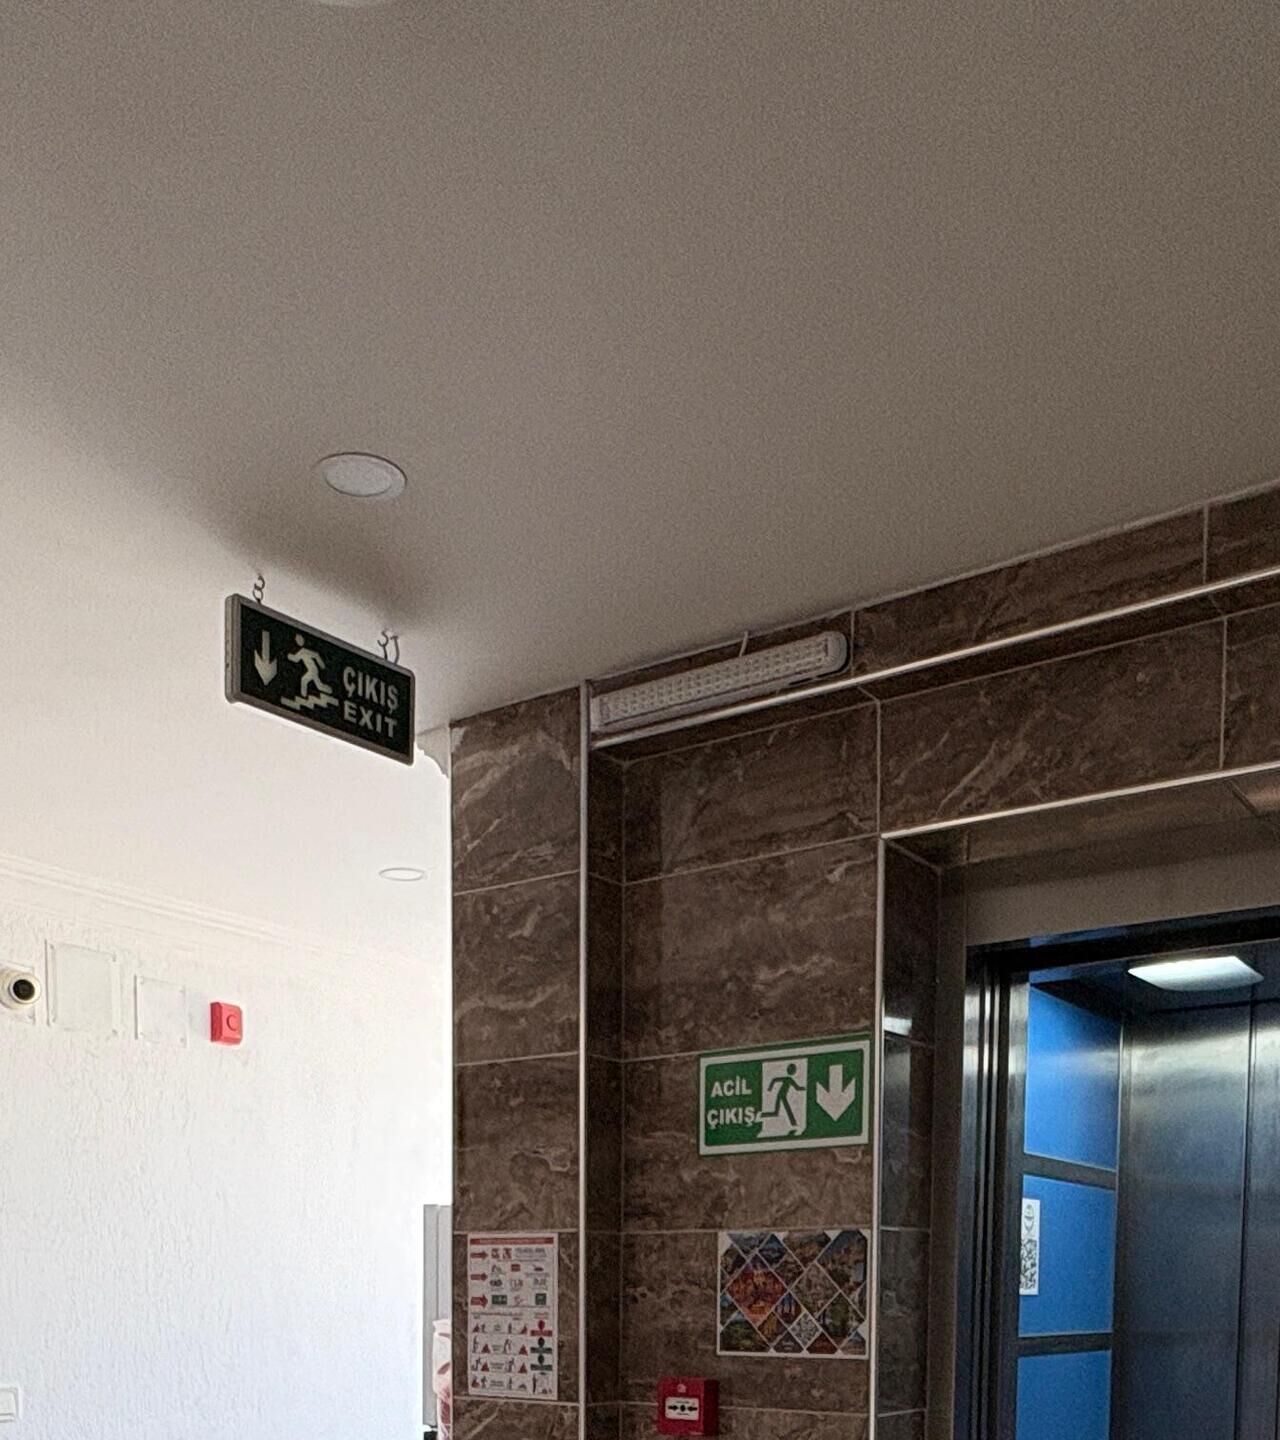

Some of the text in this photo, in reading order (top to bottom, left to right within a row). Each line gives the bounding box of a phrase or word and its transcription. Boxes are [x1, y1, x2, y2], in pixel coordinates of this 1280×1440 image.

[343, 666, 399, 714] ÇIKIŞ
[344, 700, 398, 738] EXIT
[710, 1075, 752, 1098] ACİL
[707, 1106, 756, 1130] ÇIKIŞ
